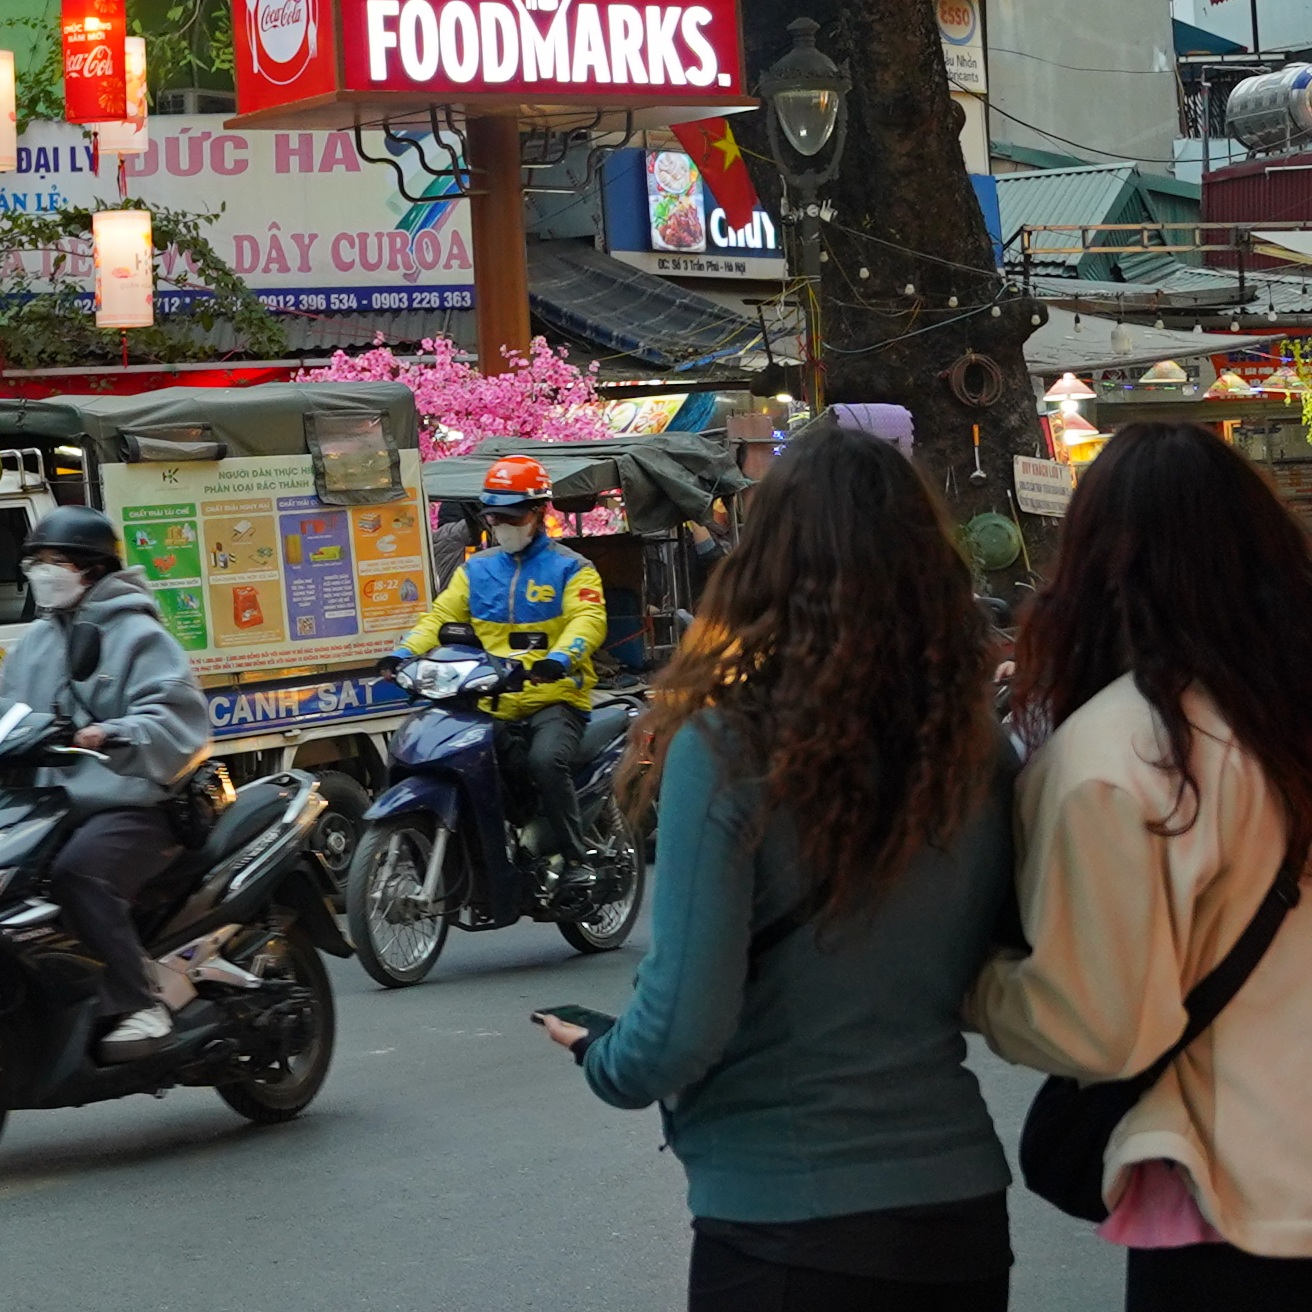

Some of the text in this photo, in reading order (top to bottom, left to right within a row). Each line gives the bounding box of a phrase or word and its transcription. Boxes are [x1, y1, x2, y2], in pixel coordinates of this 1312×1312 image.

[234, 221, 318, 275] DÂY
[330, 229, 473, 273] CUROA
[299, 294, 326, 310] 396
[330, 293, 357, 309] 534
[372, 291, 411, 308] 0903
[414, 291, 439, 307] 226
[443, 290, 471, 307] 363
[526, 579, 556, 603] be
